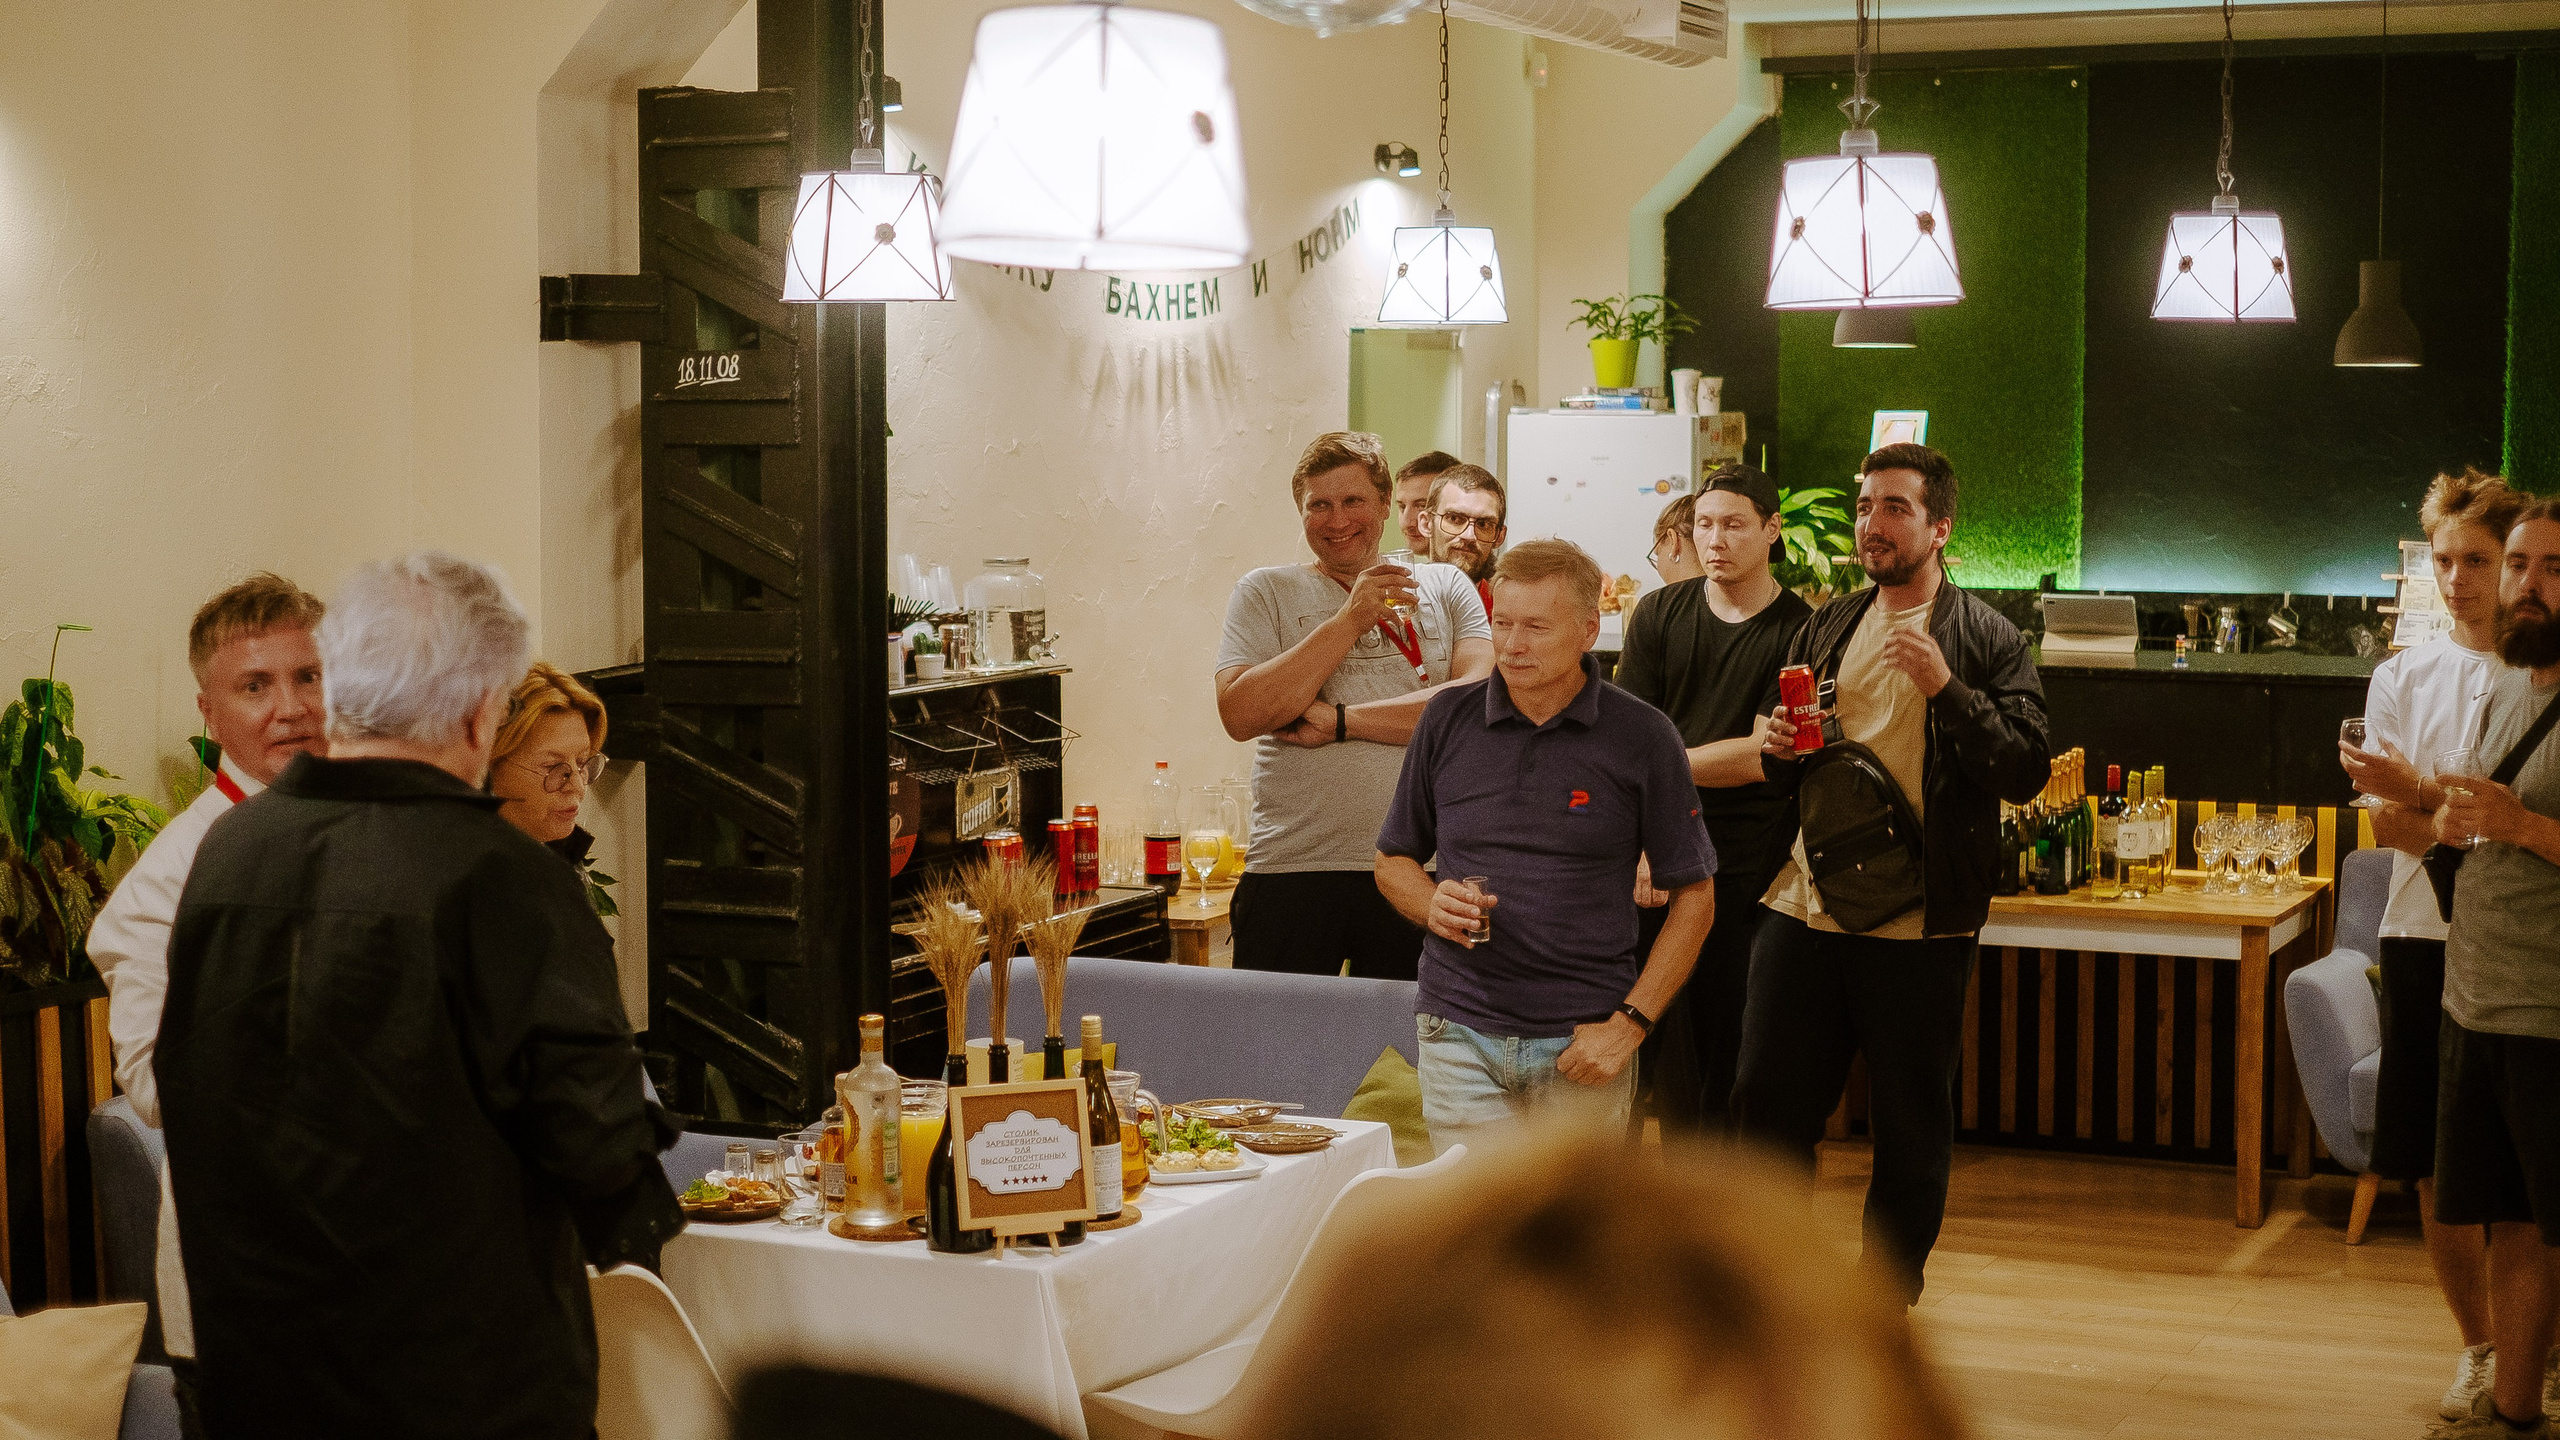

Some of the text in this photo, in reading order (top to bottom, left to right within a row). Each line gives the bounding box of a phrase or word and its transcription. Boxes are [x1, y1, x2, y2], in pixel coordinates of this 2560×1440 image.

[1105, 276, 1221, 321] БАХНЕМ
[1252, 258, 1268, 298] И
[677, 354, 740, 383] 18.11.08
[1794, 703, 1819, 715] ESTRE
[961, 796, 993, 836] COFFEE
[1003, 1128, 1040, 1139] СТОЛИК
[985, 1136, 1060, 1148] ЗАРЕЗЕРВИРОВАН
[1014, 1146, 1031, 1154] ДЛЯ
[980, 1151, 1068, 1165] ВЫСОКОПОЧТЕННЫХ
[1007, 1163, 1042, 1172] ПЕРСОН
